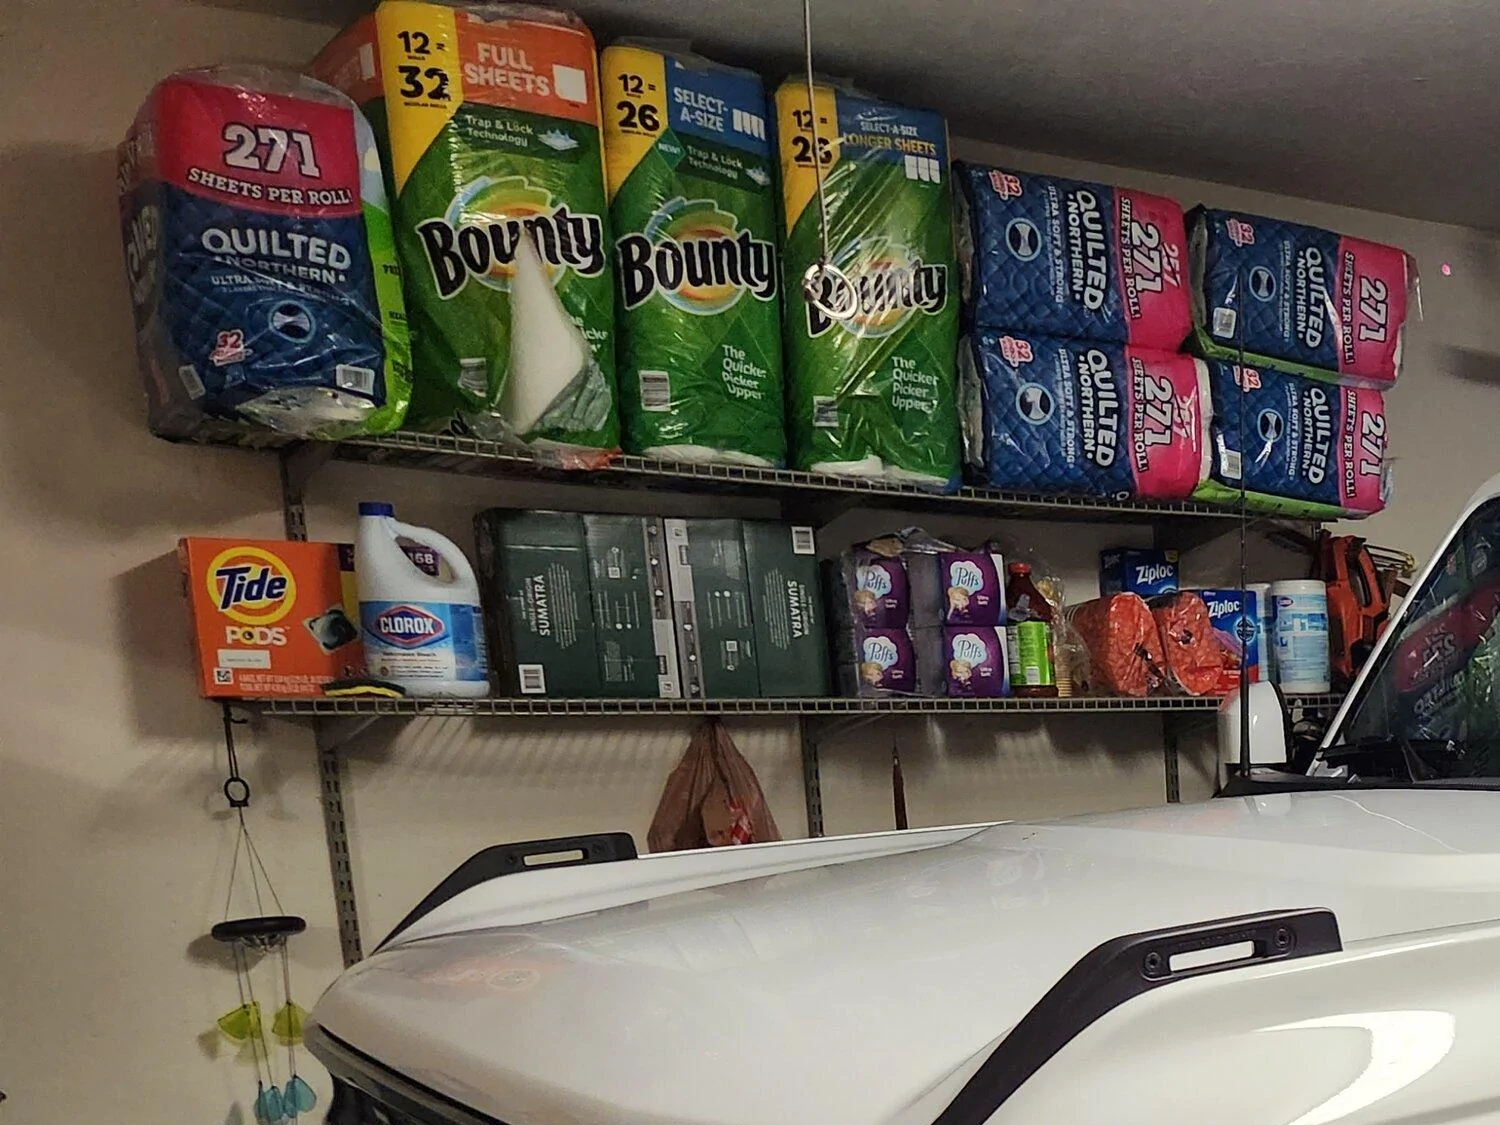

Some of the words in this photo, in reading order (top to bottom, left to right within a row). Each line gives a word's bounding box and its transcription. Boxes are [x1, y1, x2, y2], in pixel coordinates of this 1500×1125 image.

[397, 30, 431, 55] 12
[476, 42, 533, 72] FULL
[397, 65, 451, 101] 32
[463, 62, 551, 97] SHEETS
[617, 73, 645, 95] 12
[673, 86, 728, 114] SELECT-
[464, 114, 493, 130] Trap
[494, 119, 504, 130] &
[616, 100, 660, 132] 26
[680, 106, 725, 133] A-SIZE
[792, 109, 814, 128] 12
[222, 122, 321, 179] 271
[467, 127, 529, 147] Technology
[843, 132, 892, 150] LONGER
[894, 139, 937, 156] SHEETS
[686, 145, 710, 160] Trap
[712, 152, 719, 162] &
[689, 156, 739, 180] Technology
[188, 167, 263, 200] SHEETS
[267, 189, 304, 205] PER
[308, 188, 353, 206] ROLL!
[1004, 174, 1022, 196] 32
[1048, 185, 1060, 216] ULTRA
[1052, 219, 1062, 245] SOFT
[1121, 196, 1132, 248] SHEETS
[201, 227, 352, 270] QUILTED
[416, 204, 606, 299] Bounty
[1067, 199, 1084, 292] NORTHERN
[1076, 190, 1107, 310] QUILTED
[1130, 220, 1164, 294] 271
[616, 230, 777, 310] Bounty
[1122, 249, 1133, 276] PER
[211, 275, 252, 286] ULTRA
[1295, 257, 1306, 332] NORTHERN
[1126, 276, 1142, 320] ROLL!
[1305, 246, 1325, 348] QUILTED
[1342, 297, 1353, 323] PER
[1359, 275, 1388, 344] 271
[218, 331, 244, 349] 32
[722, 344, 746, 360] The
[1015, 340, 1031, 362] 32
[1343, 323, 1355, 365] ROLL!
[892, 356, 916, 369] The
[1058, 348, 1070, 379] ULTRA
[892, 369, 939, 386] Quicker
[892, 382, 930, 397] Picker
[1246, 369, 1261, 388] 32
[1063, 380, 1073, 406] SOFT
[1078, 362, 1094, 451] NORTHERN
[1087, 350, 1119, 467] QUILTED
[1133, 404, 1144, 431] PER
[1145, 375, 1173, 446] 271
[1346, 390, 1357, 433] SHEETS
[1066, 420, 1075, 463] STRONG
[1302, 397, 1313, 470] NORTHERN
[1308, 388, 1331, 484] QUILTED
[1343, 434, 1354, 461] PER
[1359, 411, 1386, 477] 271
[1134, 430, 1148, 472] ROLL!
[1344, 461, 1355, 498] ROLL!
[215, 566, 288, 611] Tide
[864, 570, 887, 591] Puffs
[955, 567, 979, 587] Puffs
[1135, 564, 1174, 585] Ziploc
[533, 574, 551, 637] SUMATRA
[787, 580, 802, 638] SUMATRA
[1206, 600, 1240, 619] Ziploc
[225, 625, 288, 647] PODS
[379, 616, 435, 635] CLOROX
[870, 643, 894, 662] Puffs
[958, 640, 982, 659] Puffs
